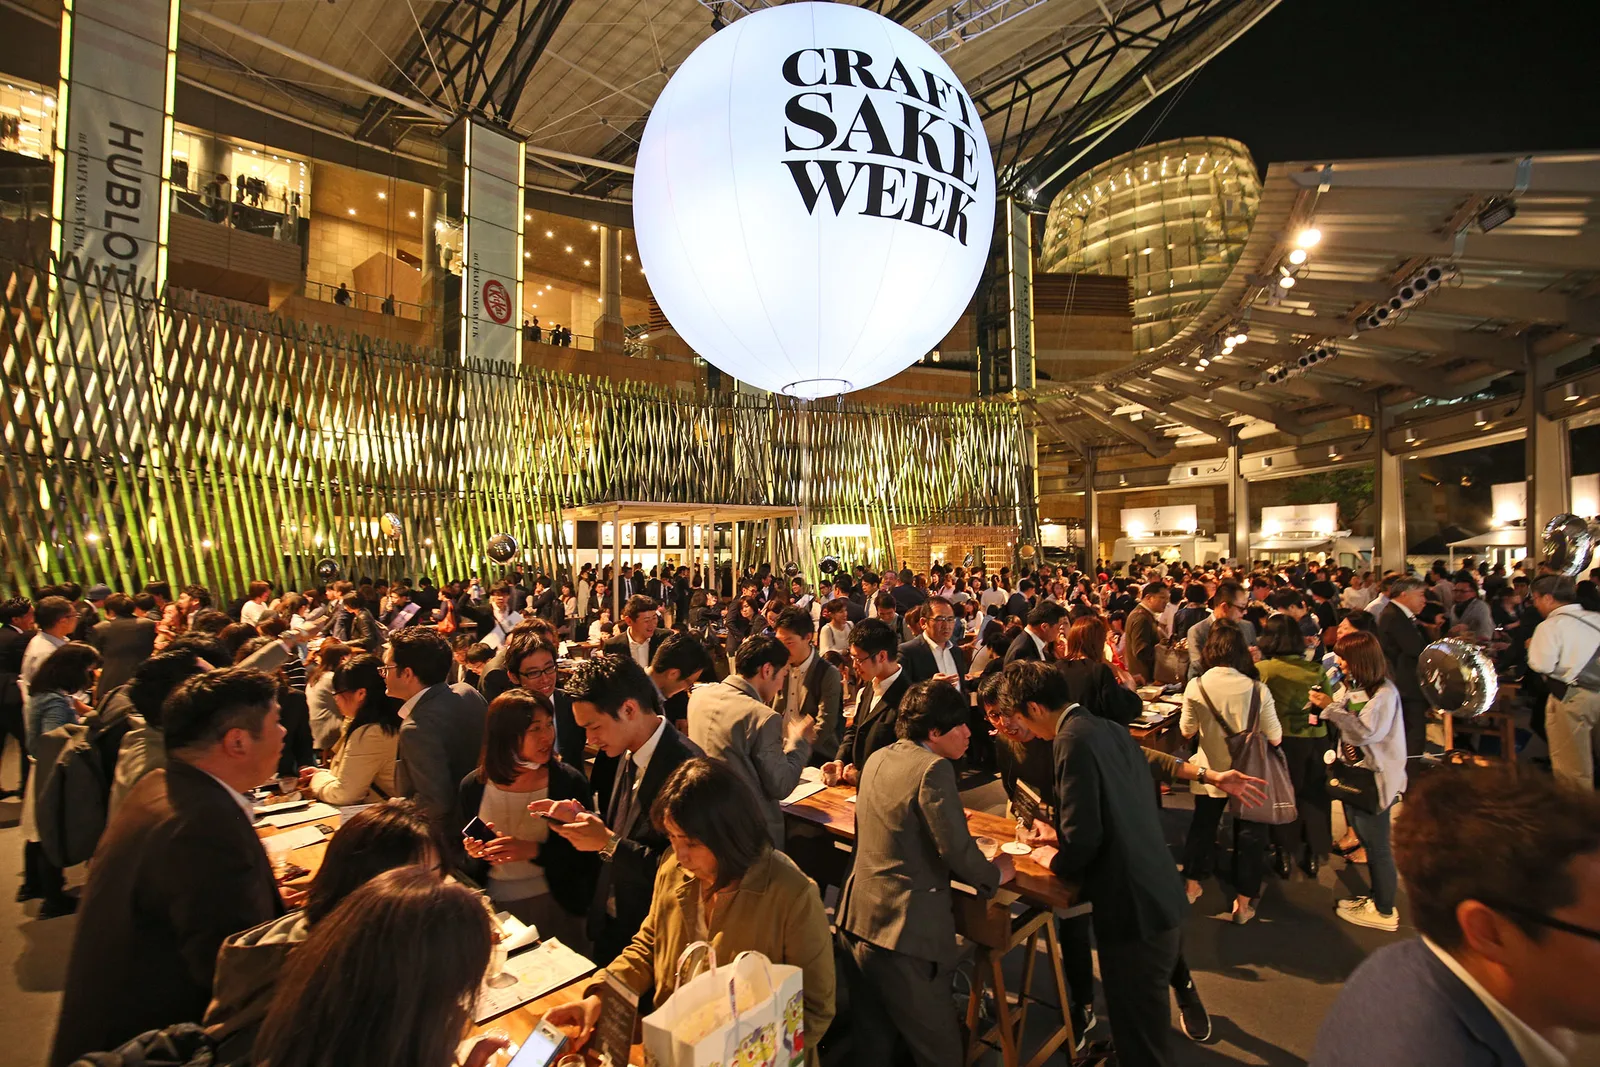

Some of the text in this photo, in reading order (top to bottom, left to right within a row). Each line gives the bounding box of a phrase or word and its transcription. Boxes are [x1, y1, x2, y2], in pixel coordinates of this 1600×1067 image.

[782, 47, 973, 133] CRAFT
[76, 146, 89, 183] CRAFT
[784, 92, 979, 192] SAKE
[73, 215, 87, 251] WEEK
[74, 184, 88, 215] SAKE
[102, 121, 144, 284] HUBLOT
[781, 160, 976, 246] WEEK
